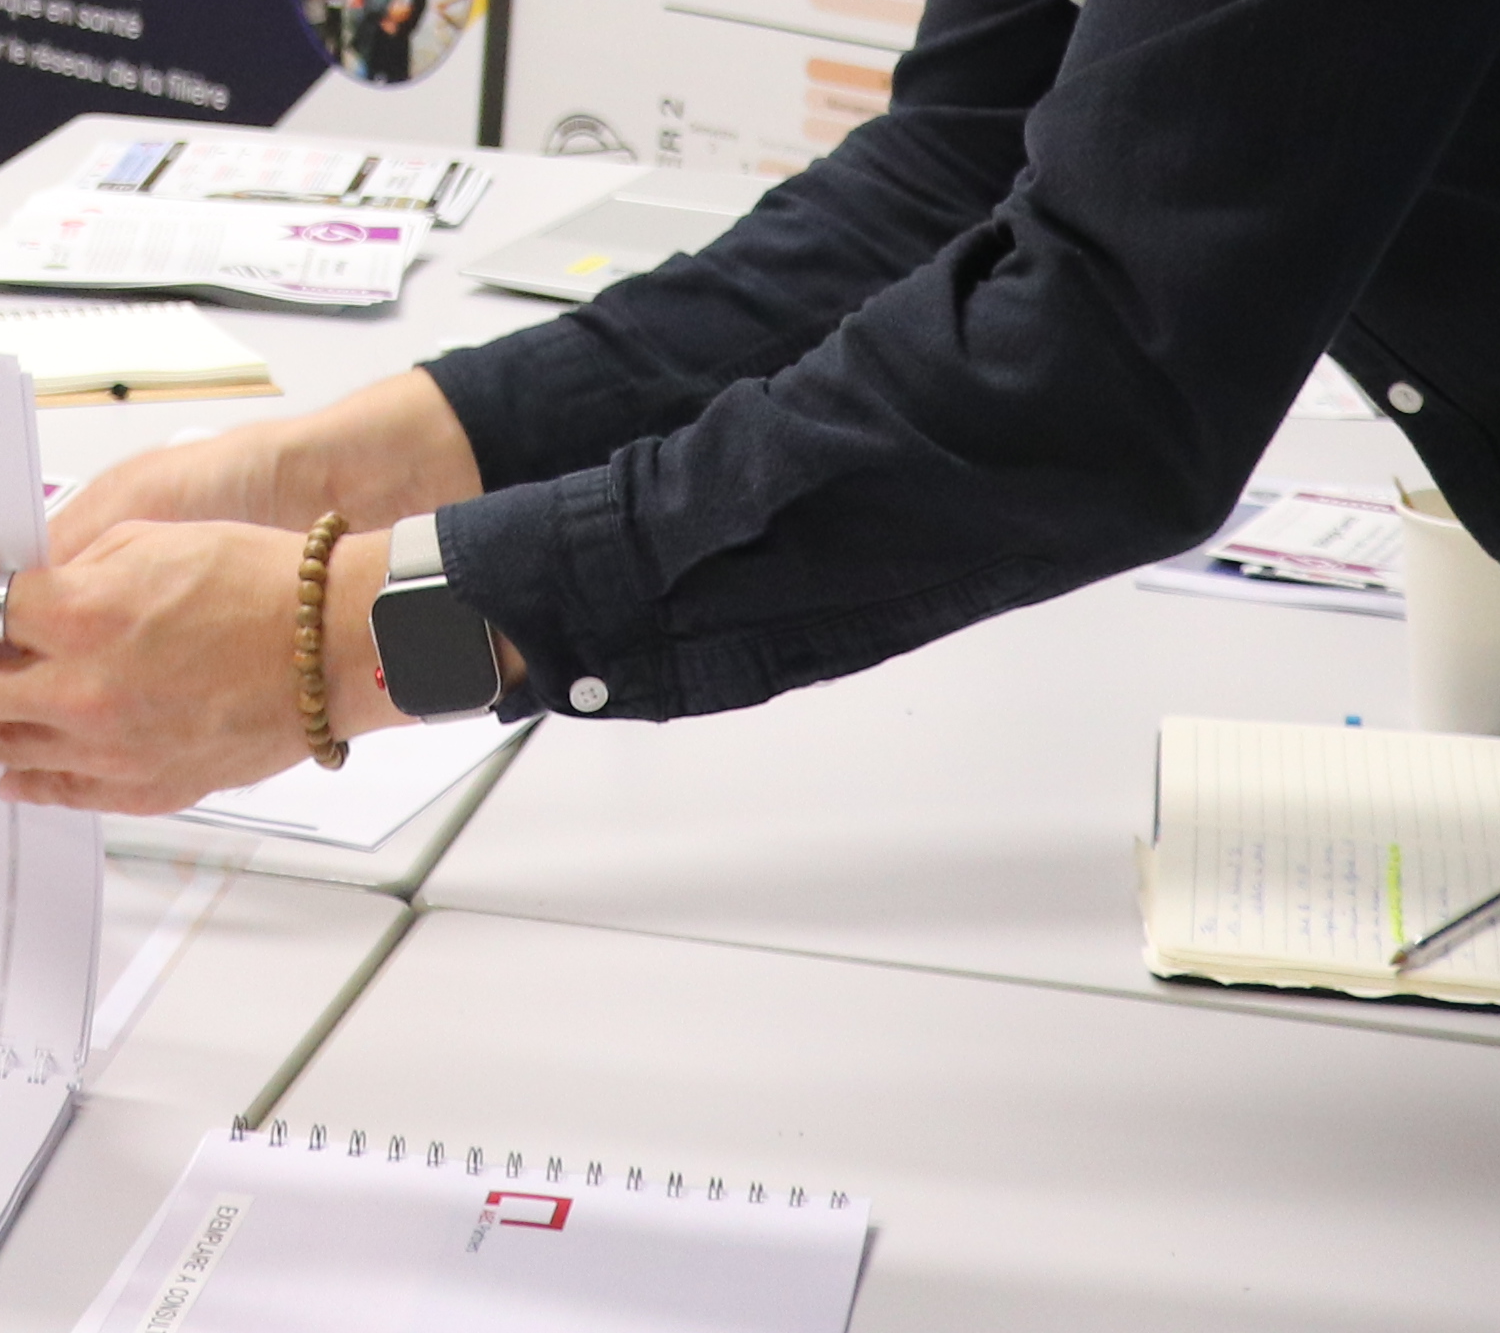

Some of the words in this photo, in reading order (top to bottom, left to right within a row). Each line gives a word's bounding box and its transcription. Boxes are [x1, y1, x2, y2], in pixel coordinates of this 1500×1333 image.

[44, 0, 73, 25] en
[76, 0, 142, 39] santé
[8, 34, 26, 66] le
[31, 39, 102, 82] réseau
[106, 56, 139, 90] de
[141, 63, 165, 96] la
[166, 69, 229, 110] filière
[183, 1204, 238, 1272] EXEMPLAIRE
[175, 1274, 195, 1285] A
[146, 1287, 190, 1333] CONSUL
